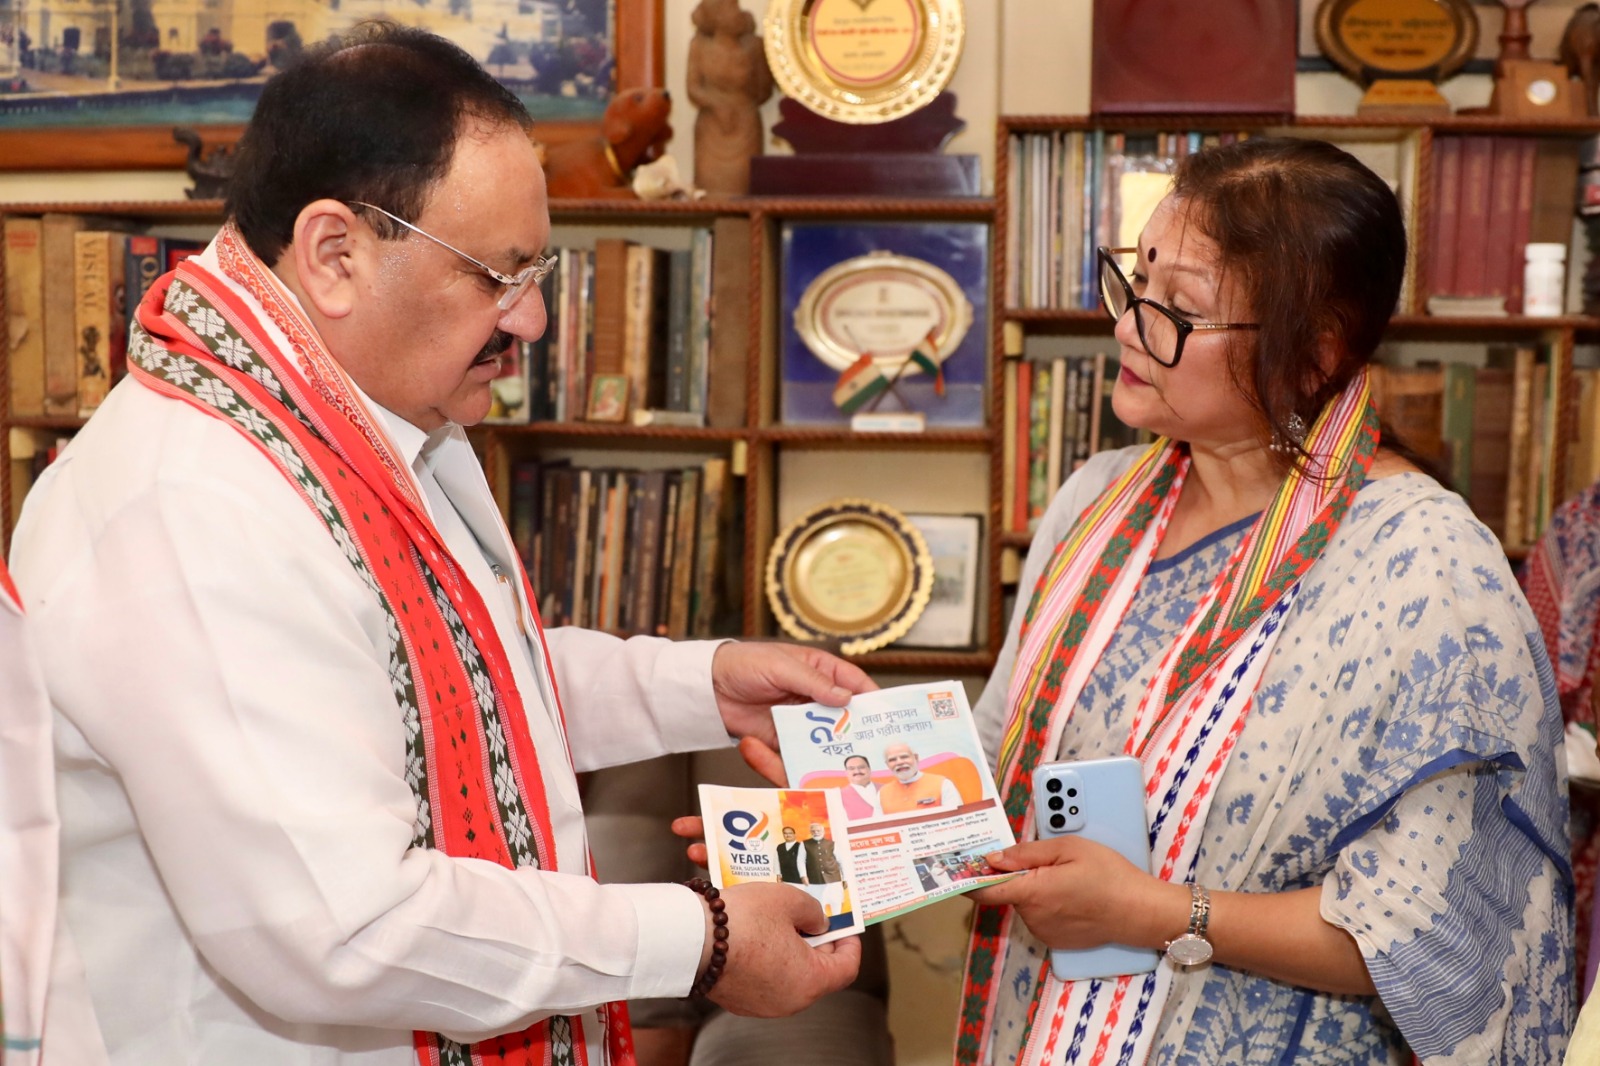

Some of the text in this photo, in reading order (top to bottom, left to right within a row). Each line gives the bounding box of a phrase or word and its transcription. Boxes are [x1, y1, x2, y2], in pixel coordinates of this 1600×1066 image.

[885, 708, 918, 723] সুশাসন
[819, 742, 854, 756] বছর
[731, 853, 770, 865] YEARS
